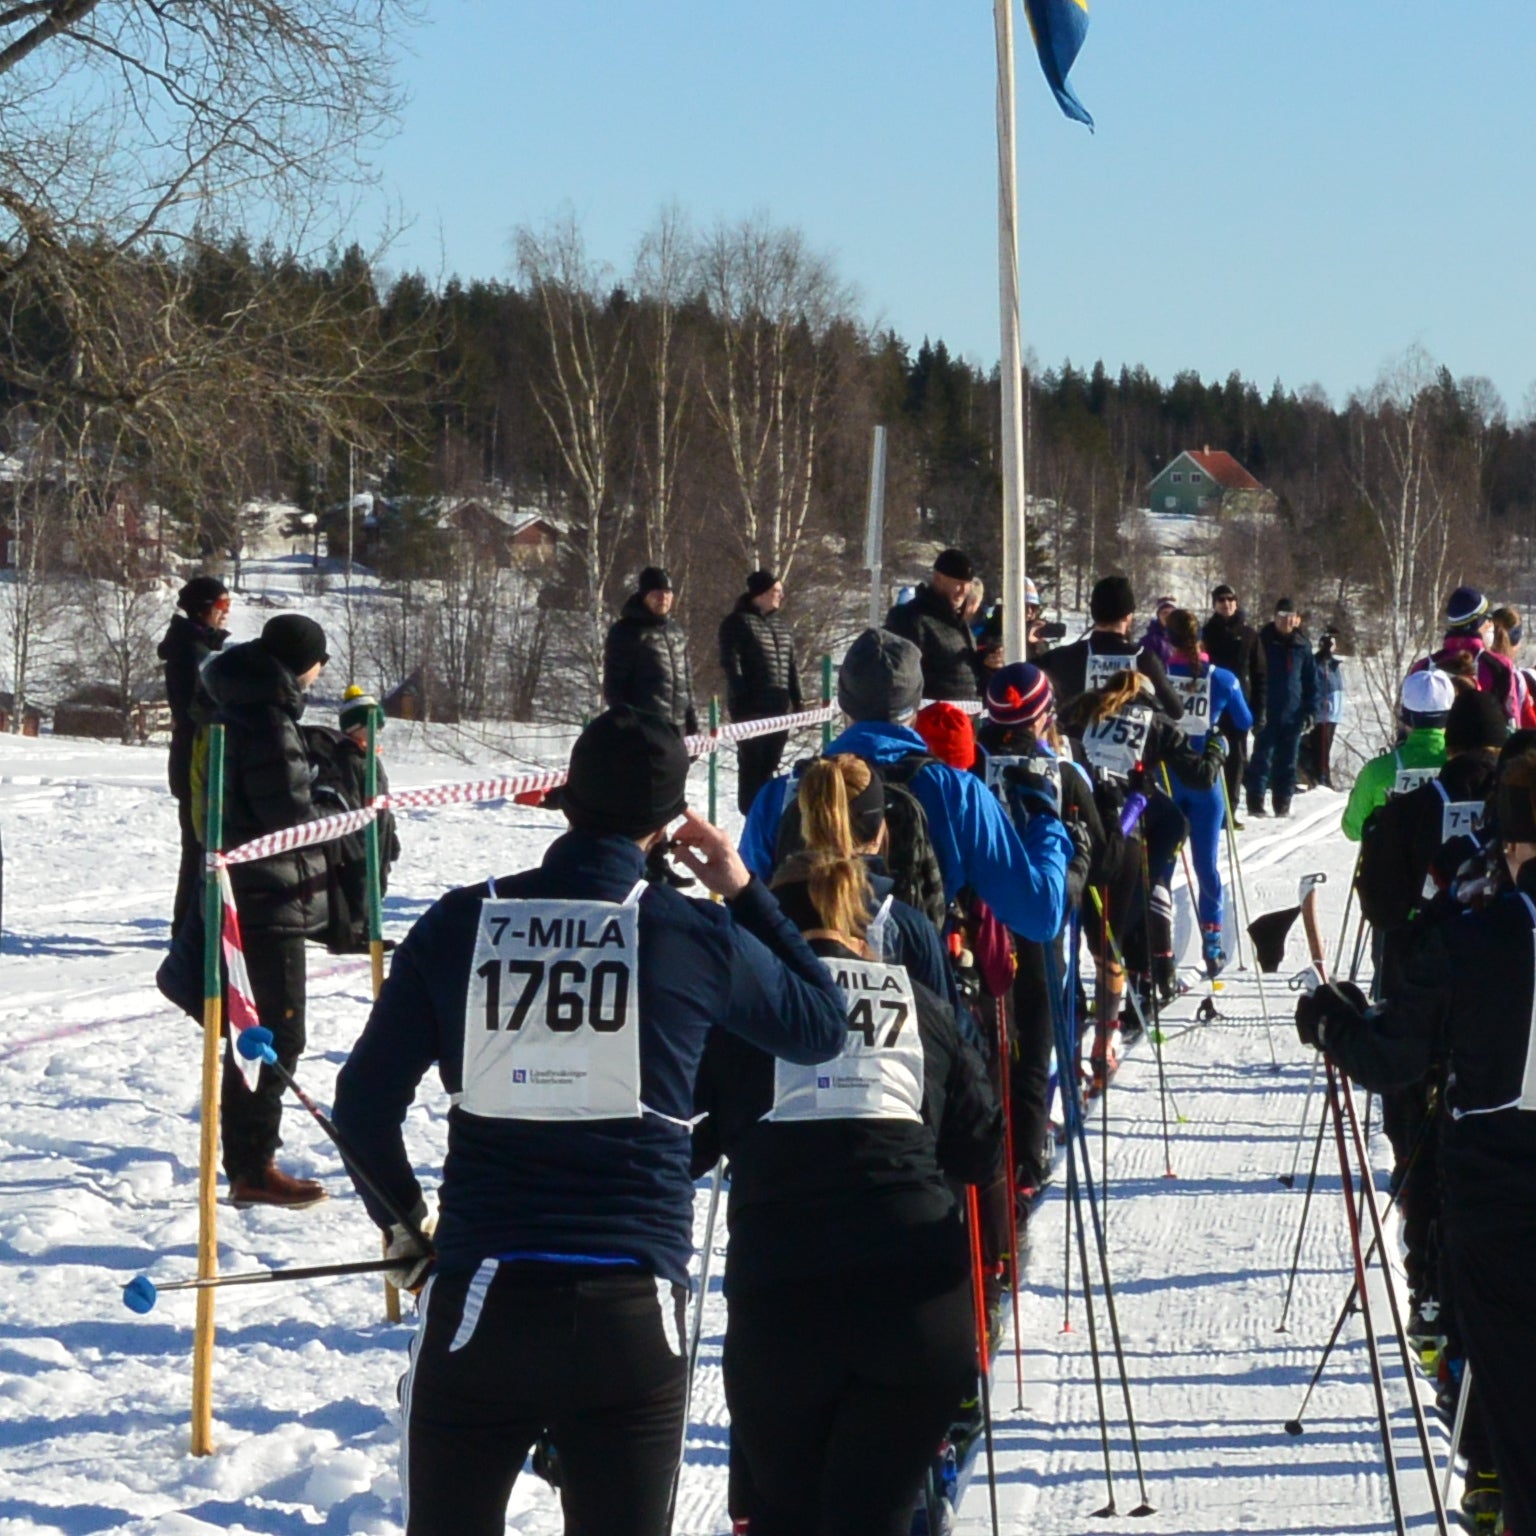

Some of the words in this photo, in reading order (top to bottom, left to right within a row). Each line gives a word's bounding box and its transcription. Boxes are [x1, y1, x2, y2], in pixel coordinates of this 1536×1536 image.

[1183, 695, 1208, 717] 40
[490, 916, 627, 949] 7-MILA
[476, 959, 630, 1033] 1760
[847, 997, 910, 1048] 47
